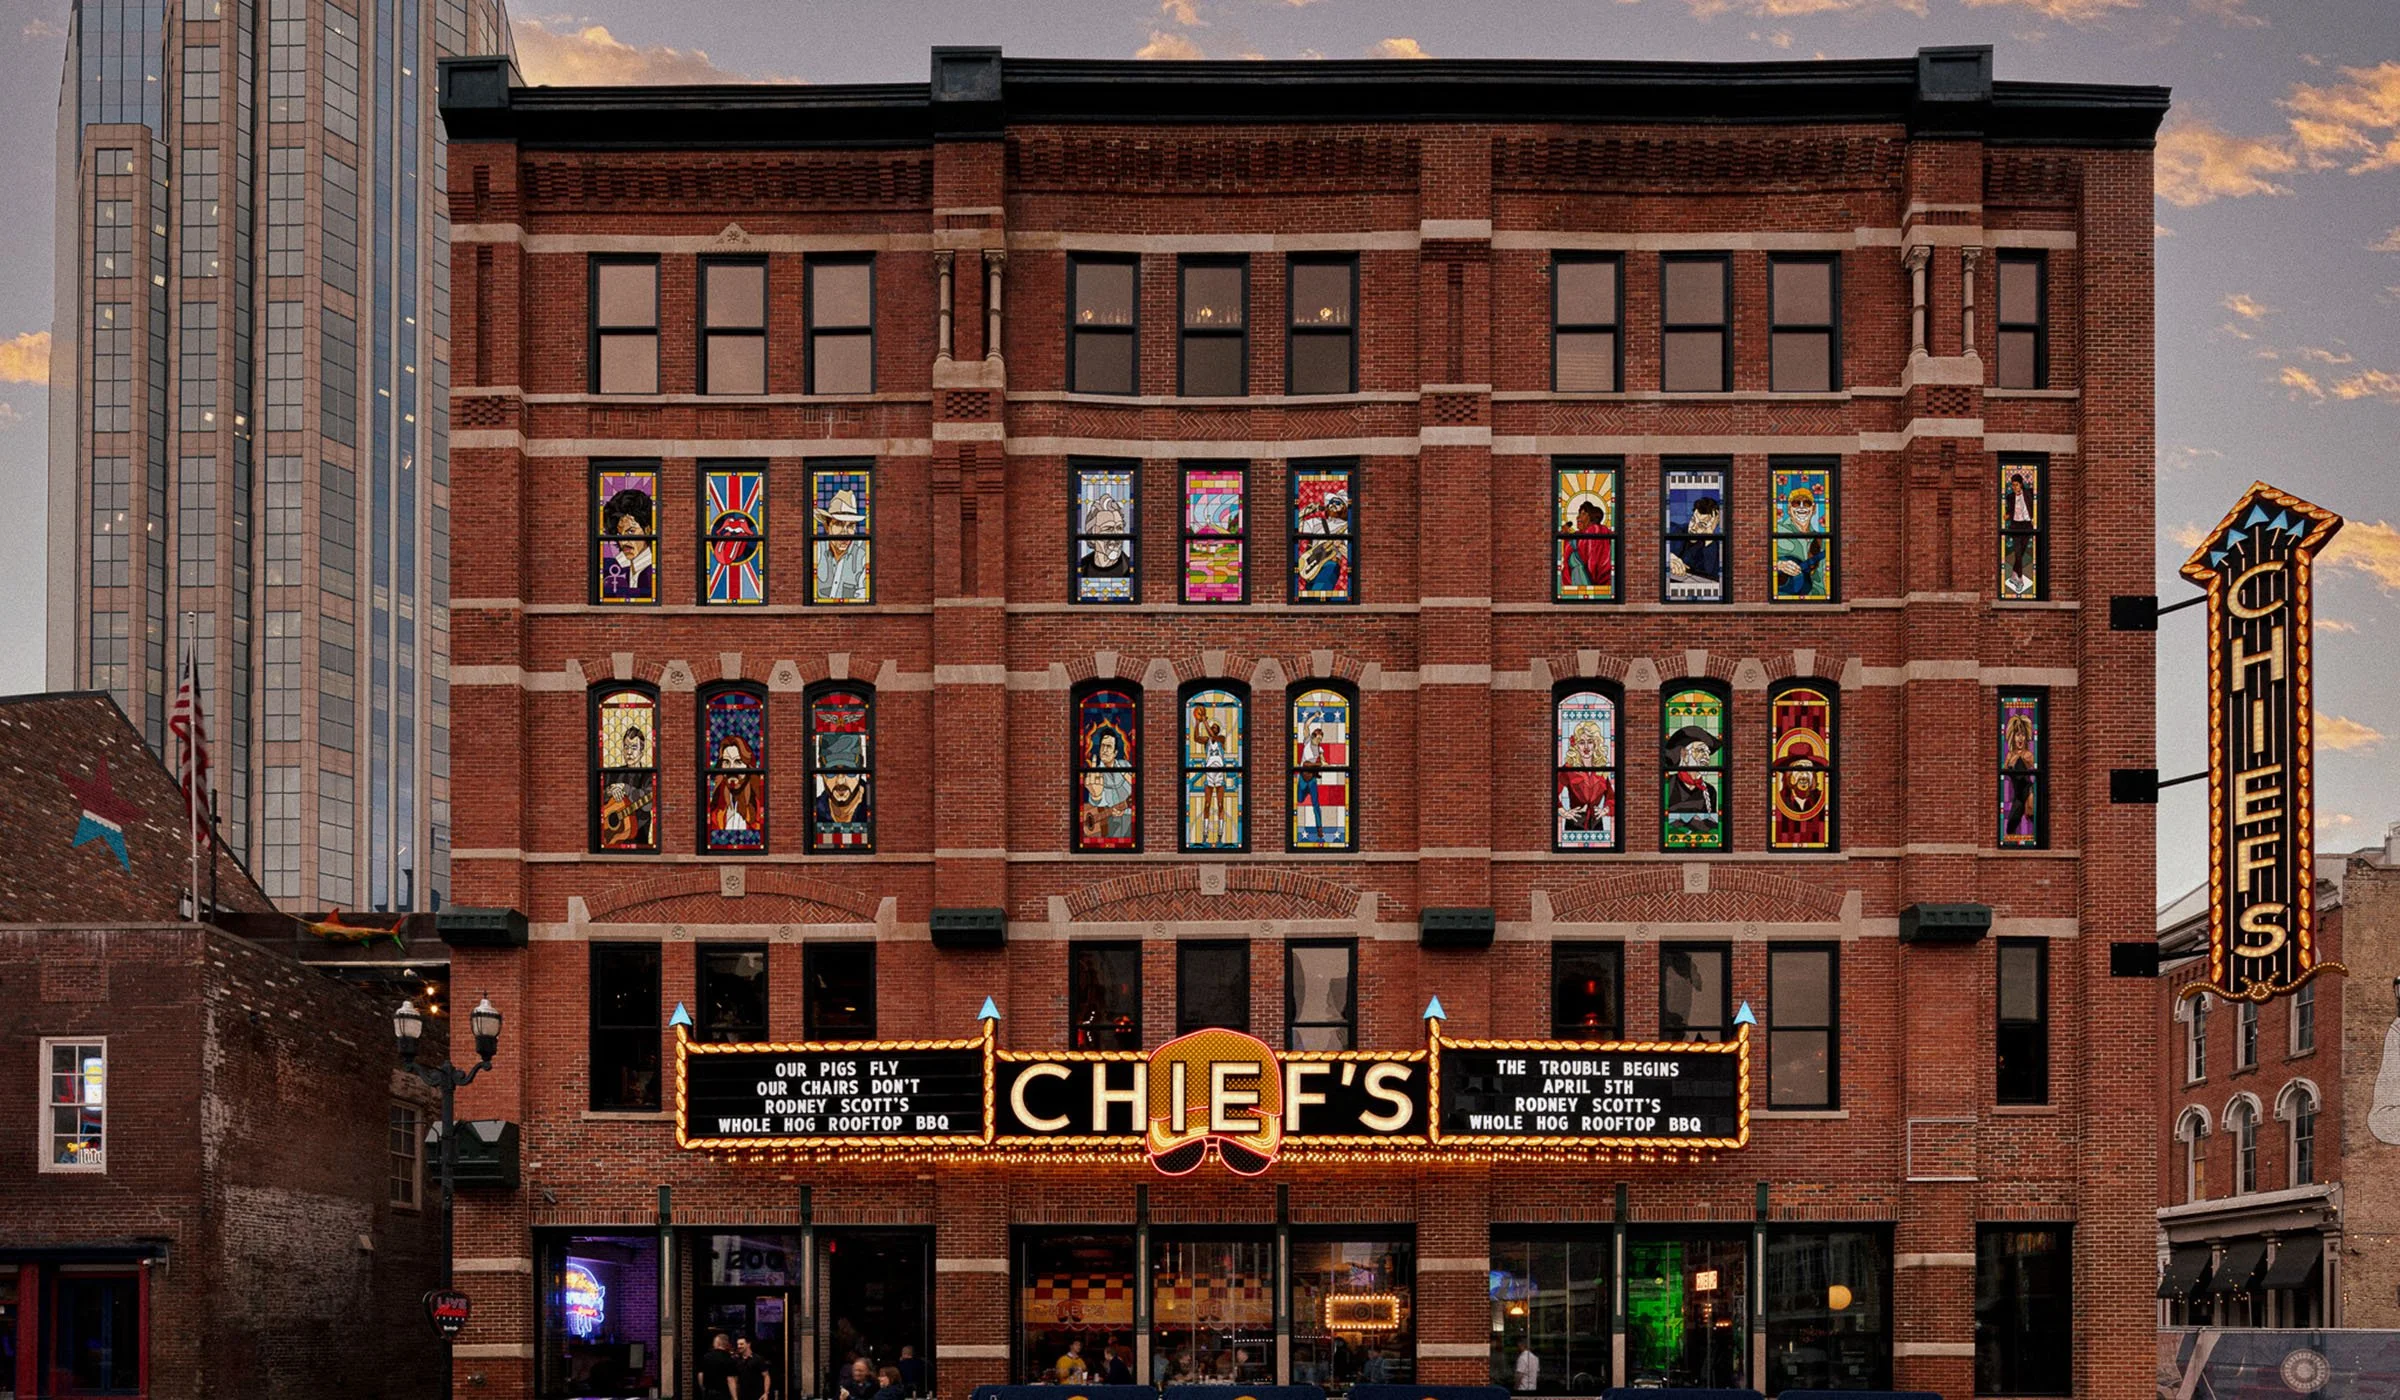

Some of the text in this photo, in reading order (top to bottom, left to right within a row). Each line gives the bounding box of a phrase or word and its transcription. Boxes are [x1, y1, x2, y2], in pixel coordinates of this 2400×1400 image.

[2227, 561, 2289, 958] CHIEFS
[775, 1060, 899, 1078] OUR PIGS FLY
[1496, 1059, 1679, 1077] THE TROUBLE BEGINS
[756, 1078, 920, 1096] OUR CHAIRS DON'T
[1542, 1078, 1634, 1095] APRIL 5TH
[765, 1096, 910, 1115] RODNEY SCOTT'S
[1010, 1062, 1413, 1132] CHIEF'S
[1515, 1096, 1661, 1114] RODNEY SCOTT'S
[718, 1114, 949, 1133] WHOLE HOG ROOFTOP BBQ
[1469, 1114, 1702, 1133] WHOLE HOG ROOFTOP BBQ
[727, 1250, 786, 1271] 200
